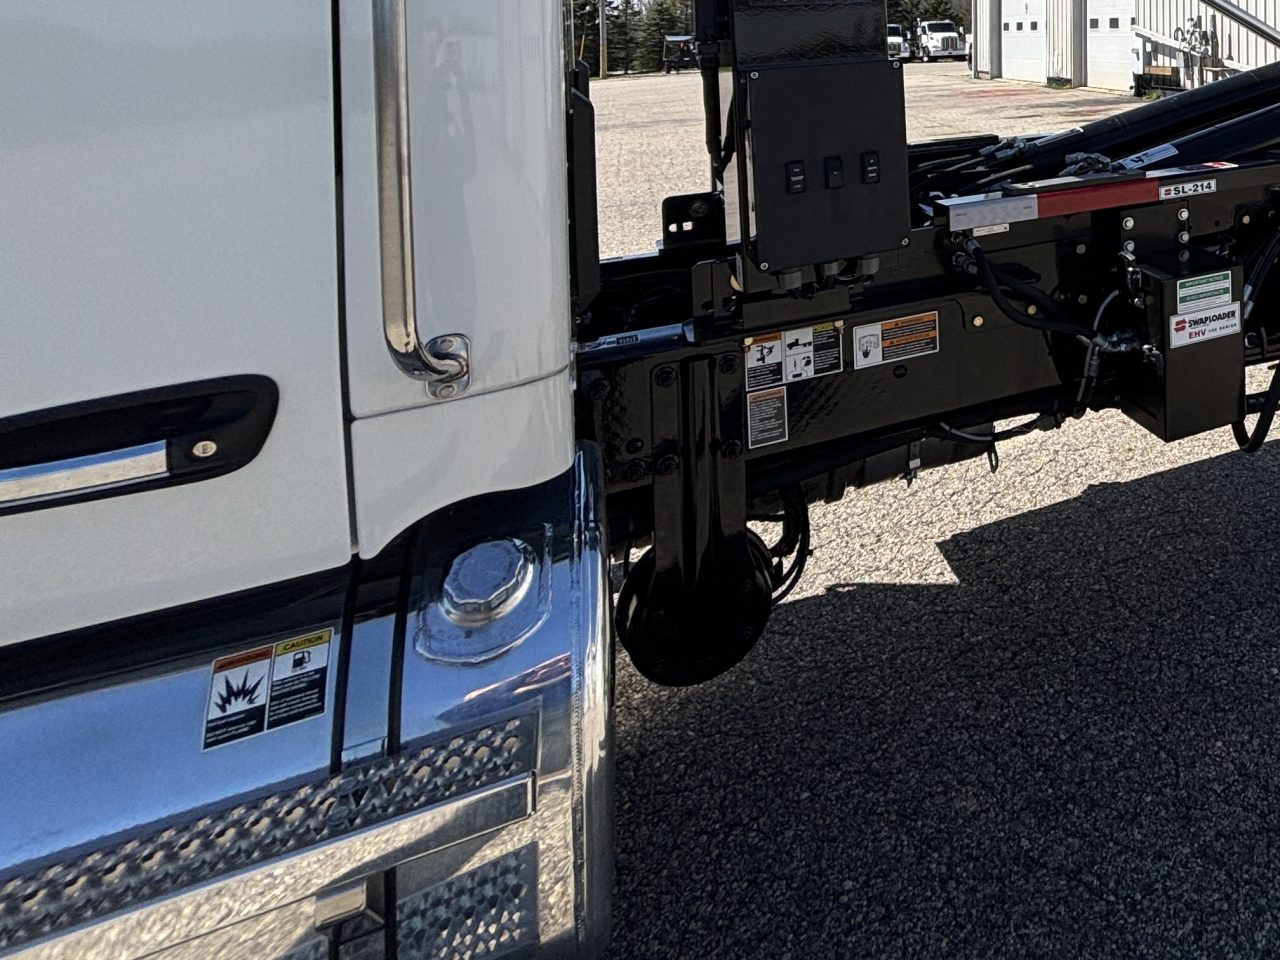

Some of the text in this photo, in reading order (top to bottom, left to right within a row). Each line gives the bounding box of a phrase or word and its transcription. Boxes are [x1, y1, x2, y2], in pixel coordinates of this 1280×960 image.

[1173, 182, 1212, 196] SL-214
[1187, 310, 1237, 328] SWAPLOADER
[1188, 328, 1207, 339] EHV
[283, 634, 324, 652] CAUTION
